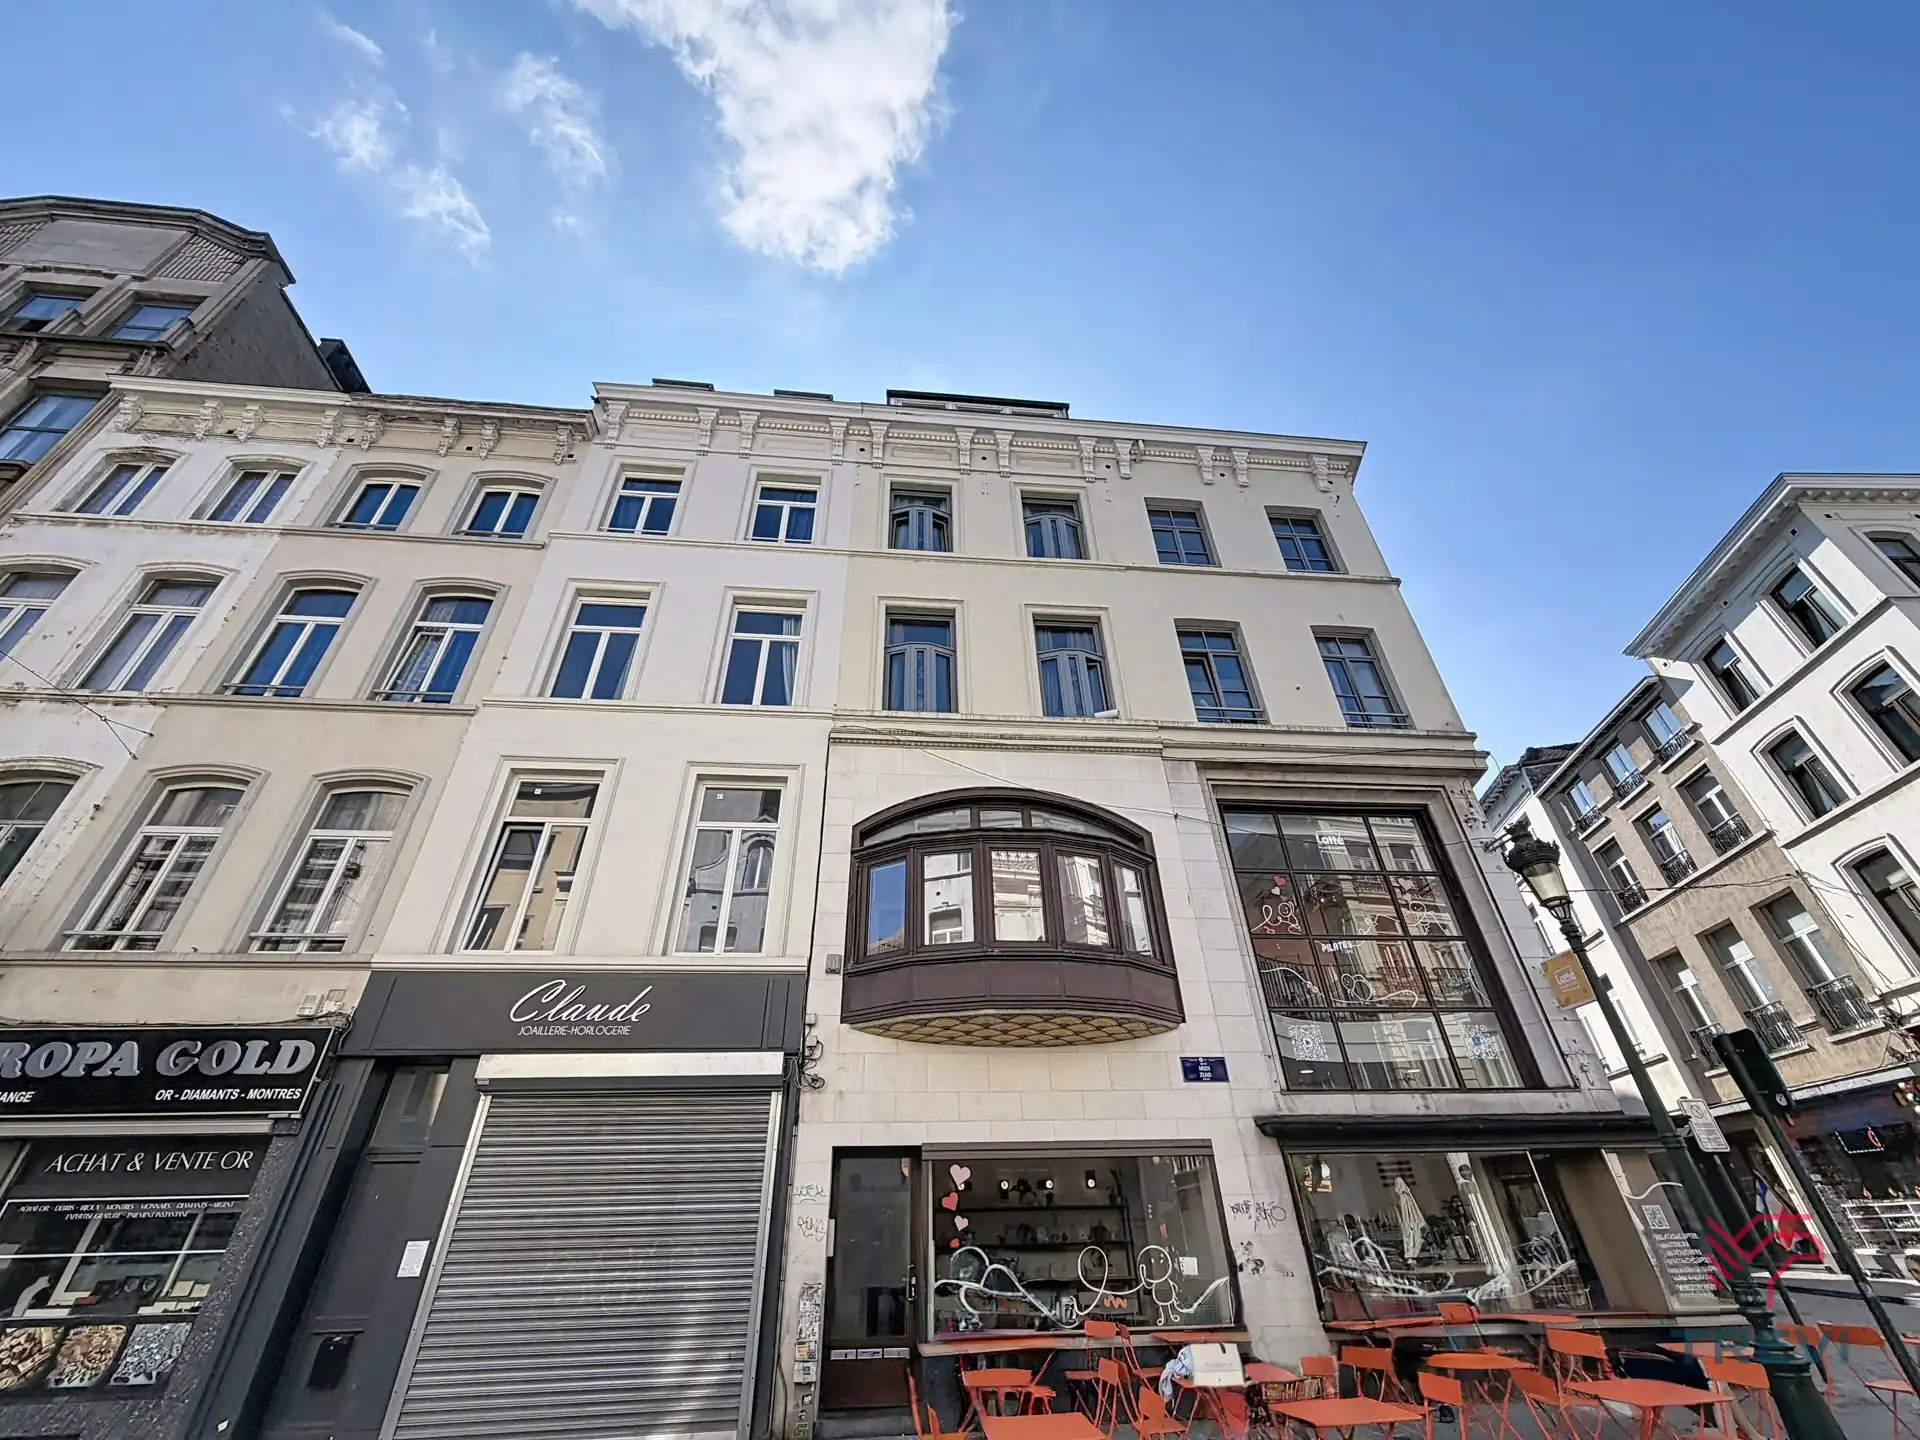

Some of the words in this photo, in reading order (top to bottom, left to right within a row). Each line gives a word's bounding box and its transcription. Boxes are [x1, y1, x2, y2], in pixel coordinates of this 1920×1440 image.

[1315, 834, 1345, 845] Latte
[1321, 940, 1353, 952] PILATES
[509, 979, 653, 1022] Claude
[517, 1025, 631, 1036] JOAILLERIE-HORLOGERIE
[156, 1040, 315, 1076] GOLD
[0, 1091, 36, 1103] ANGE
[155, 1089, 174, 1101] OR
[180, 1088, 240, 1100] DIAMANTS
[246, 1088, 302, 1099] MONTRES
[44, 1152, 126, 1173] ACHAT
[126, 1152, 145, 1172] &
[153, 1151, 217, 1170] VENTE
[220, 1150, 254, 1170] OR
